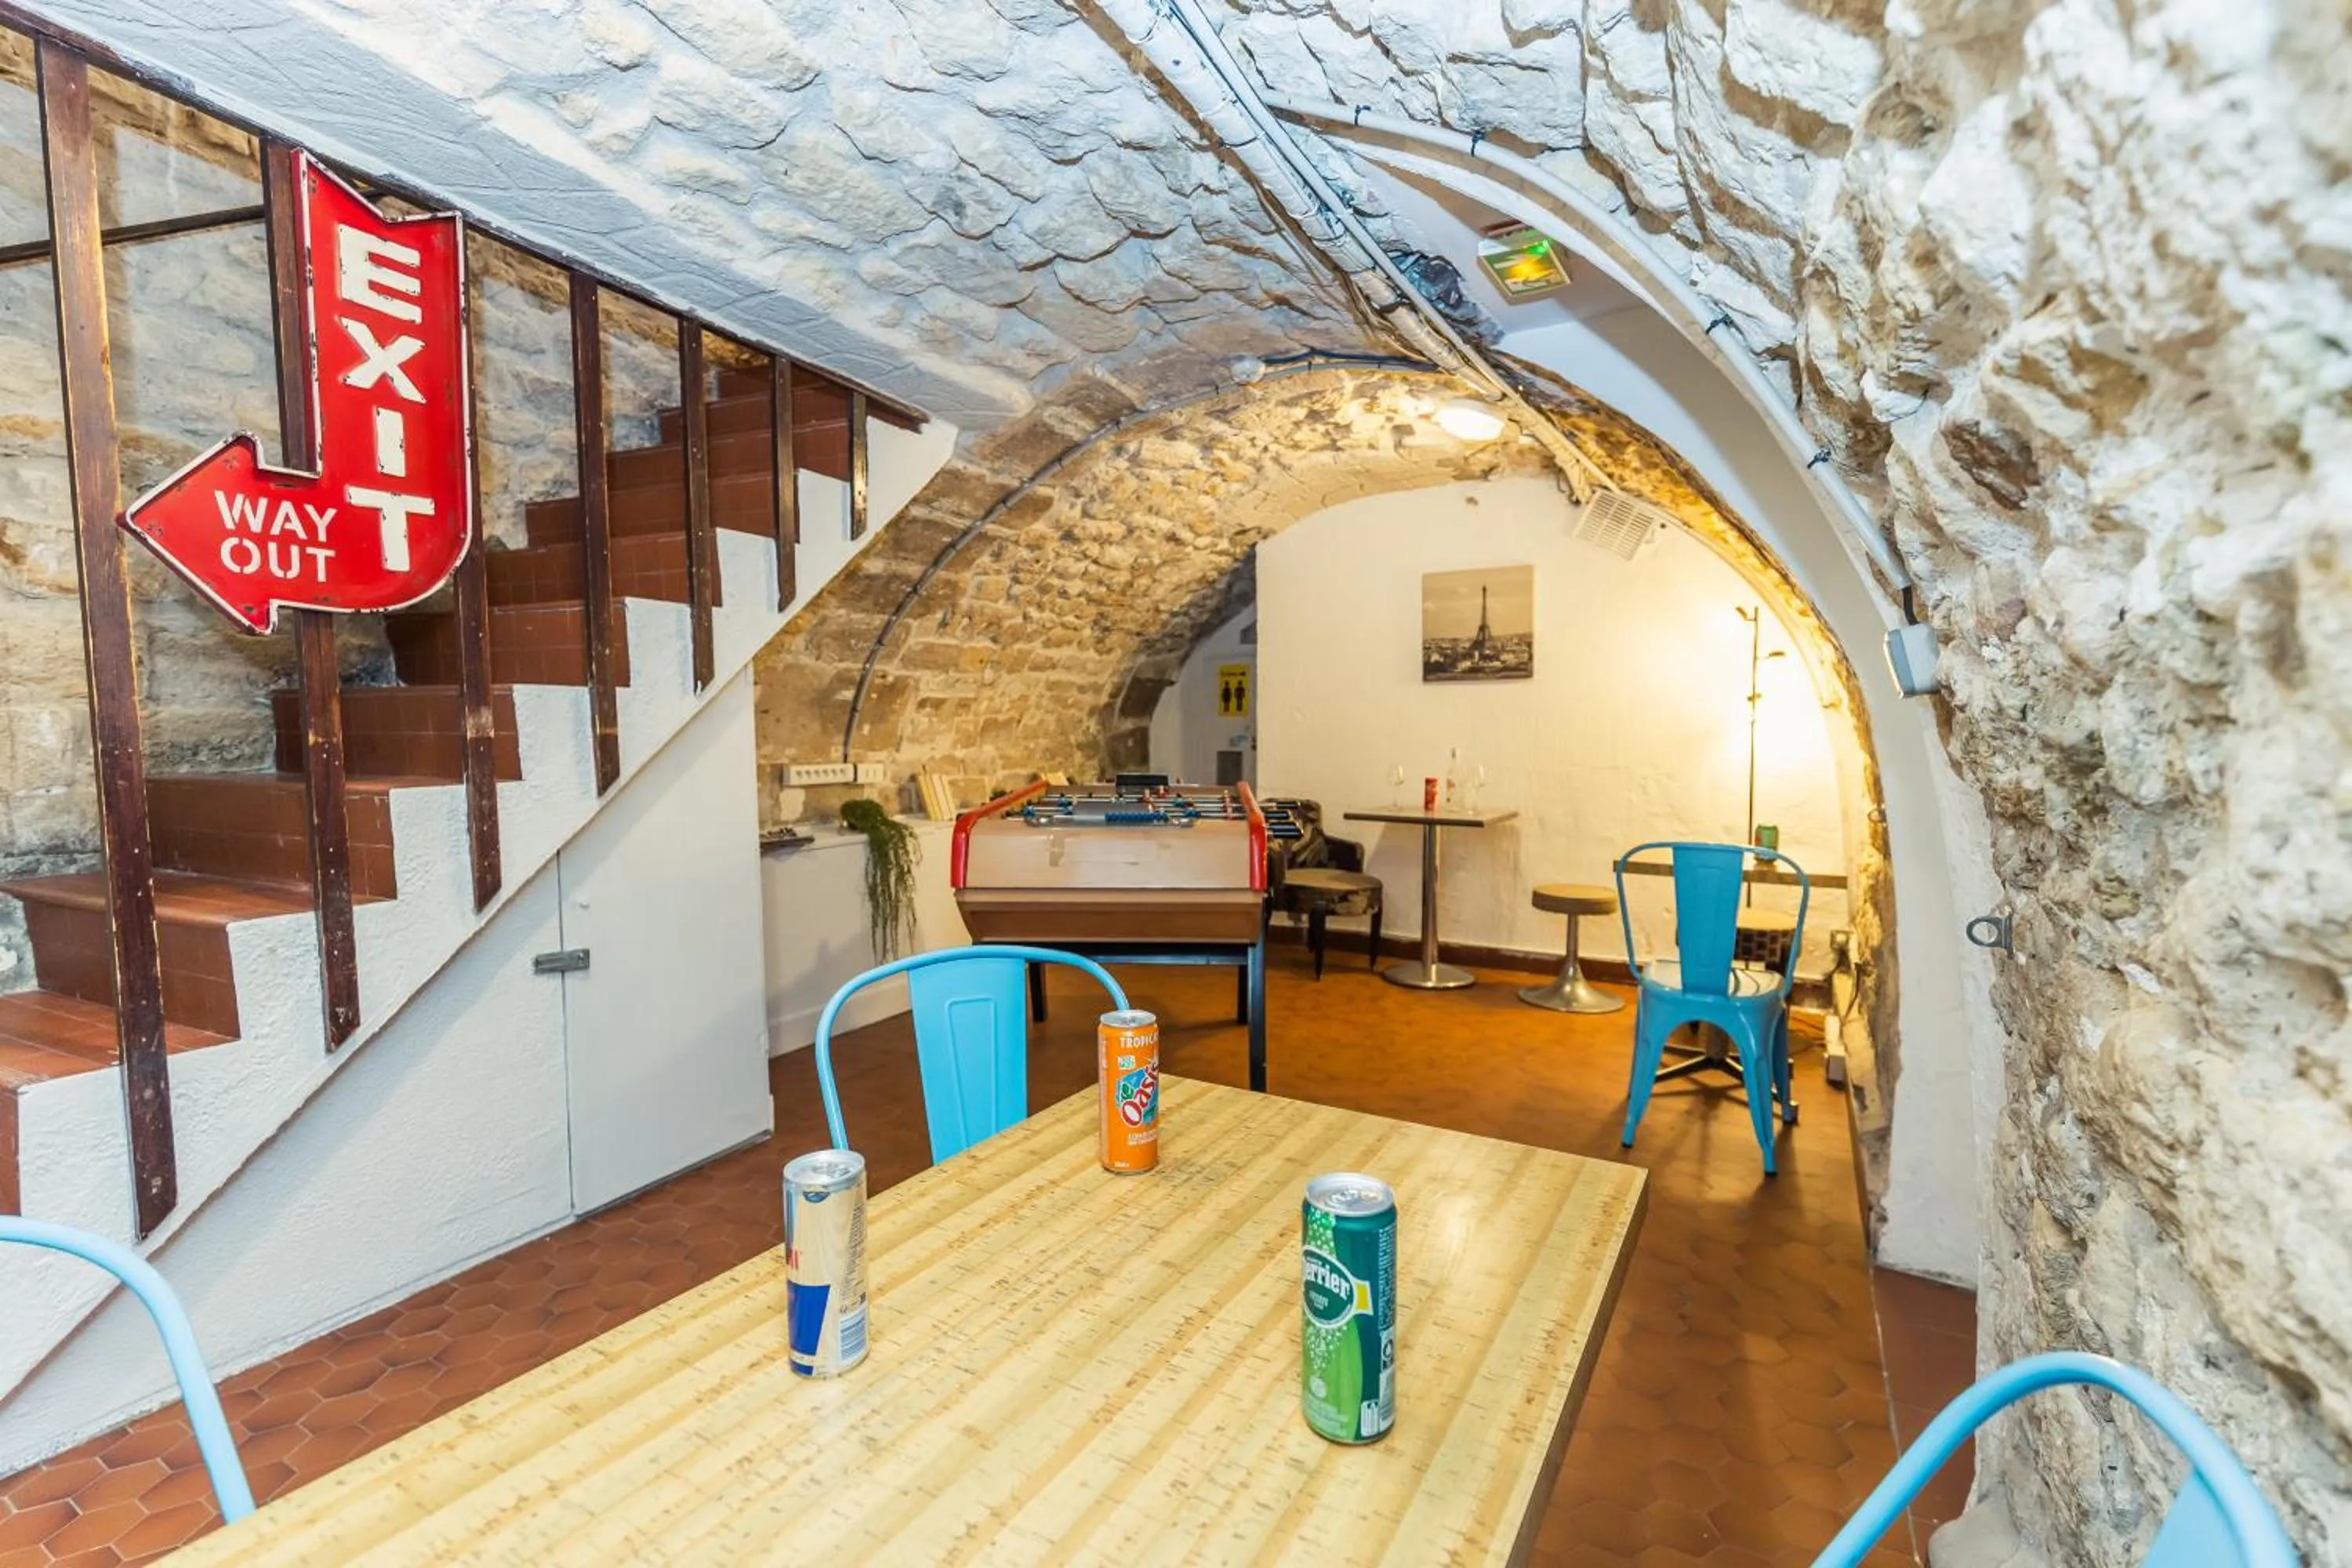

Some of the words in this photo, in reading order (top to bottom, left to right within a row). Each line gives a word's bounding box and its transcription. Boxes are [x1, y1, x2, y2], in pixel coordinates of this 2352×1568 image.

[339, 223, 435, 572] EXIT
[214, 489, 338, 543] WAY
[220, 537, 336, 583] OUT
